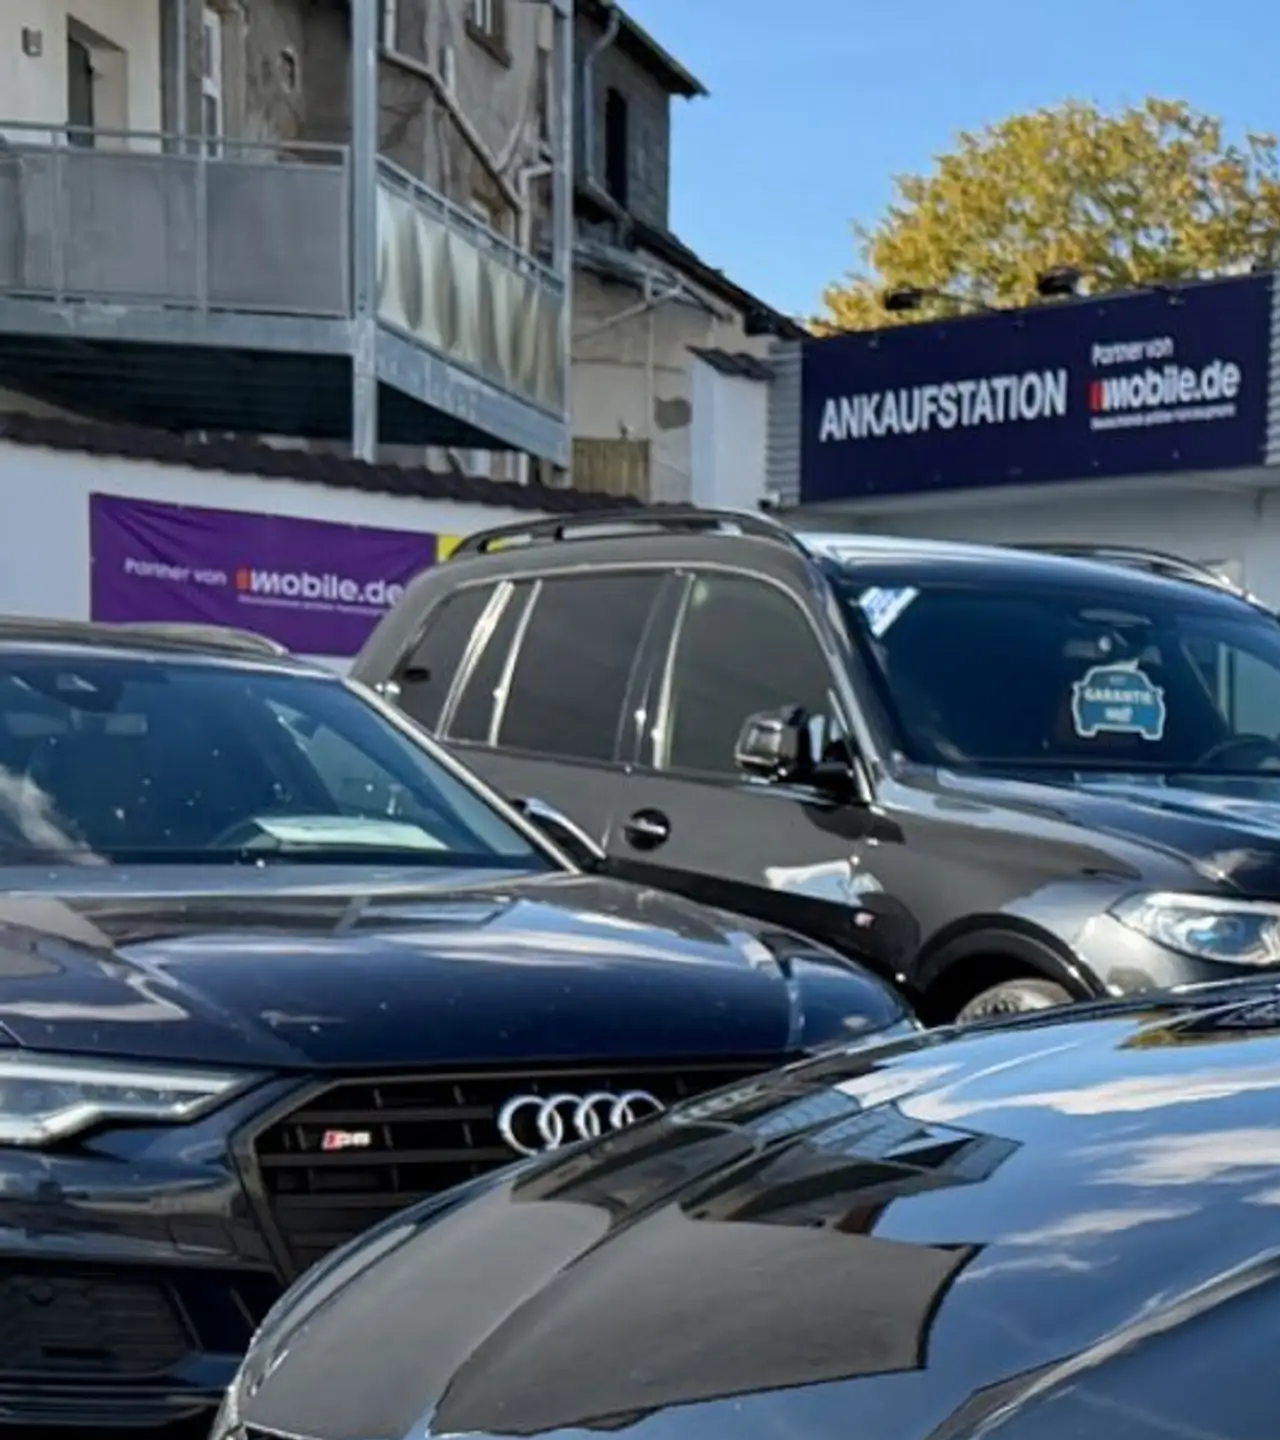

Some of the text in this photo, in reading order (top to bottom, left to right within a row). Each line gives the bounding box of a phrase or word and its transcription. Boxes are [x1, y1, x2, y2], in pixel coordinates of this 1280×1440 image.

[818, 368, 1068, 442] ANKAUFSTATION
[1088, 357, 1241, 414] mobile.de
[123, 556, 189, 582] Partner
[193, 567, 228, 585] von
